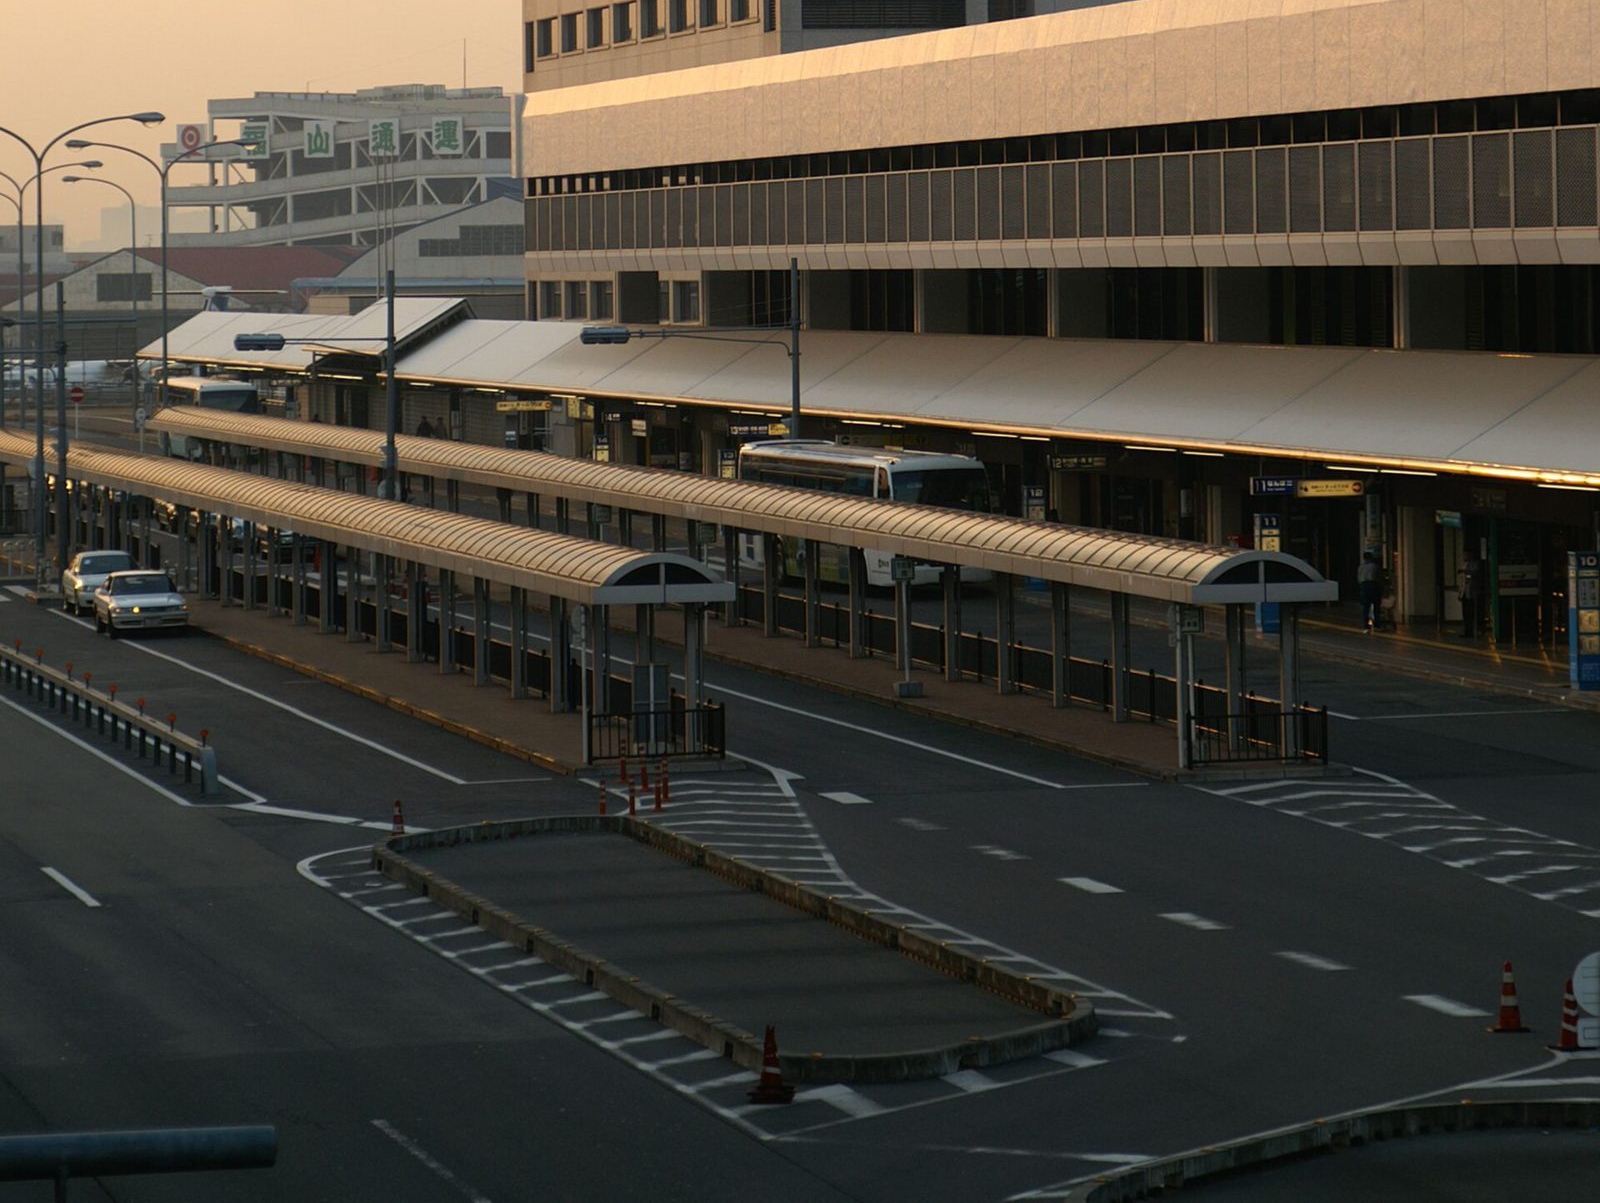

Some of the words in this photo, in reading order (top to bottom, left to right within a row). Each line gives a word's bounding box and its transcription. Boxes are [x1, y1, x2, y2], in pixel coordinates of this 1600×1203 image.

[1052, 458, 1062, 469] 12
[1255, 480, 1266, 492] 11
[1263, 517, 1277, 526] 11
[1580, 555, 1598, 567] 10
